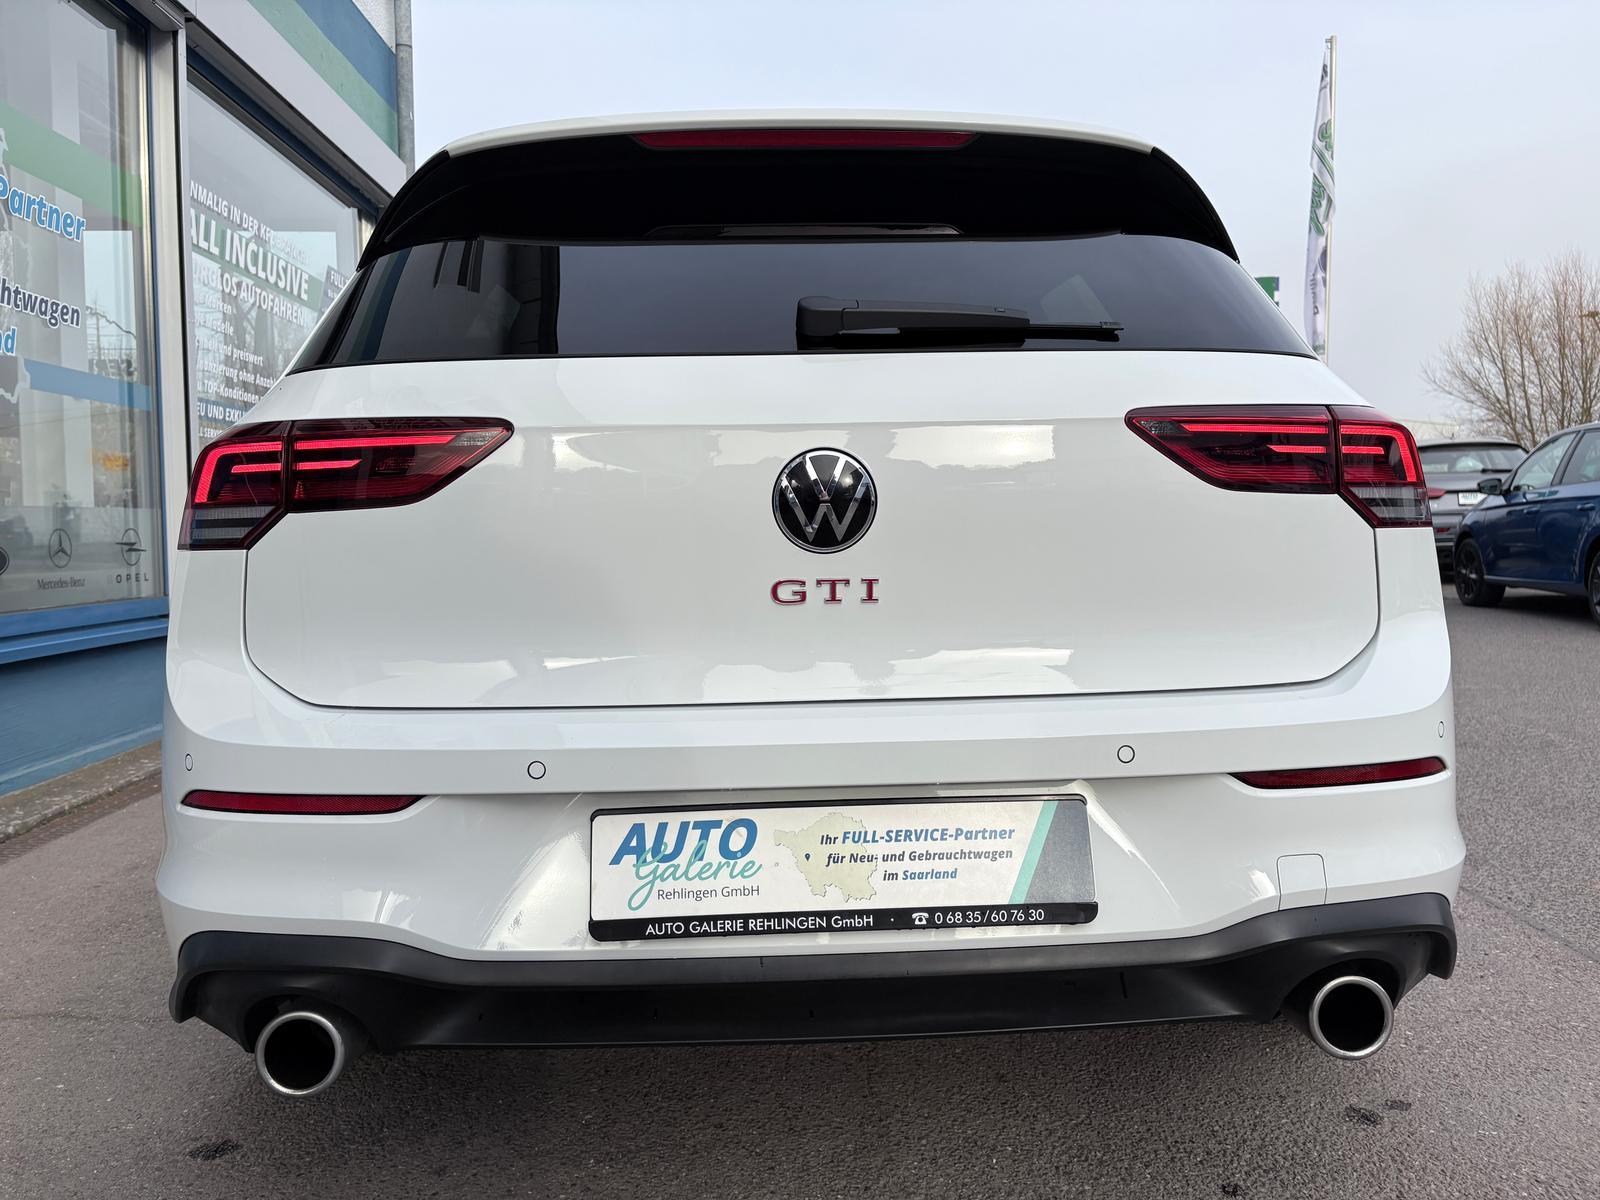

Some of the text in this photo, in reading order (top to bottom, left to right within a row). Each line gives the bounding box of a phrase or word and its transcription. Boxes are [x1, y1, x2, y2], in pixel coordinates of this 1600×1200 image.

[230, 204, 241, 224] IN
[242, 212, 259, 236] DER
[225, 227, 309, 301] INCLUSIVE
[232, 347, 264, 367] preiswert
[239, 368, 255, 384] ohne
[207, 404, 224, 420] UND
[115, 573, 150, 585] OPEL
[770, 578, 880, 606] GTI
[609, 818, 758, 866] AUTO
[820, 826, 1015, 846] Ihr FULL-SERVICE-Partner
[826, 847, 1013, 868] für Neu- und Gebrauchtwagen
[627, 839, 763, 911] Galerie
[883, 867, 958, 882] im Saarland
[657, 885, 760, 902] Rehlingen GmbH
[645, 922, 685, 936] AUTO
[689, 919, 744, 934] GALERIE
[749, 916, 827, 932] REHLINGEN
[831, 914, 873, 929] GmbH
[934, 911, 943, 924] 0
[946, 911, 963, 924] 68
[1028, 908, 1045, 921] 30
